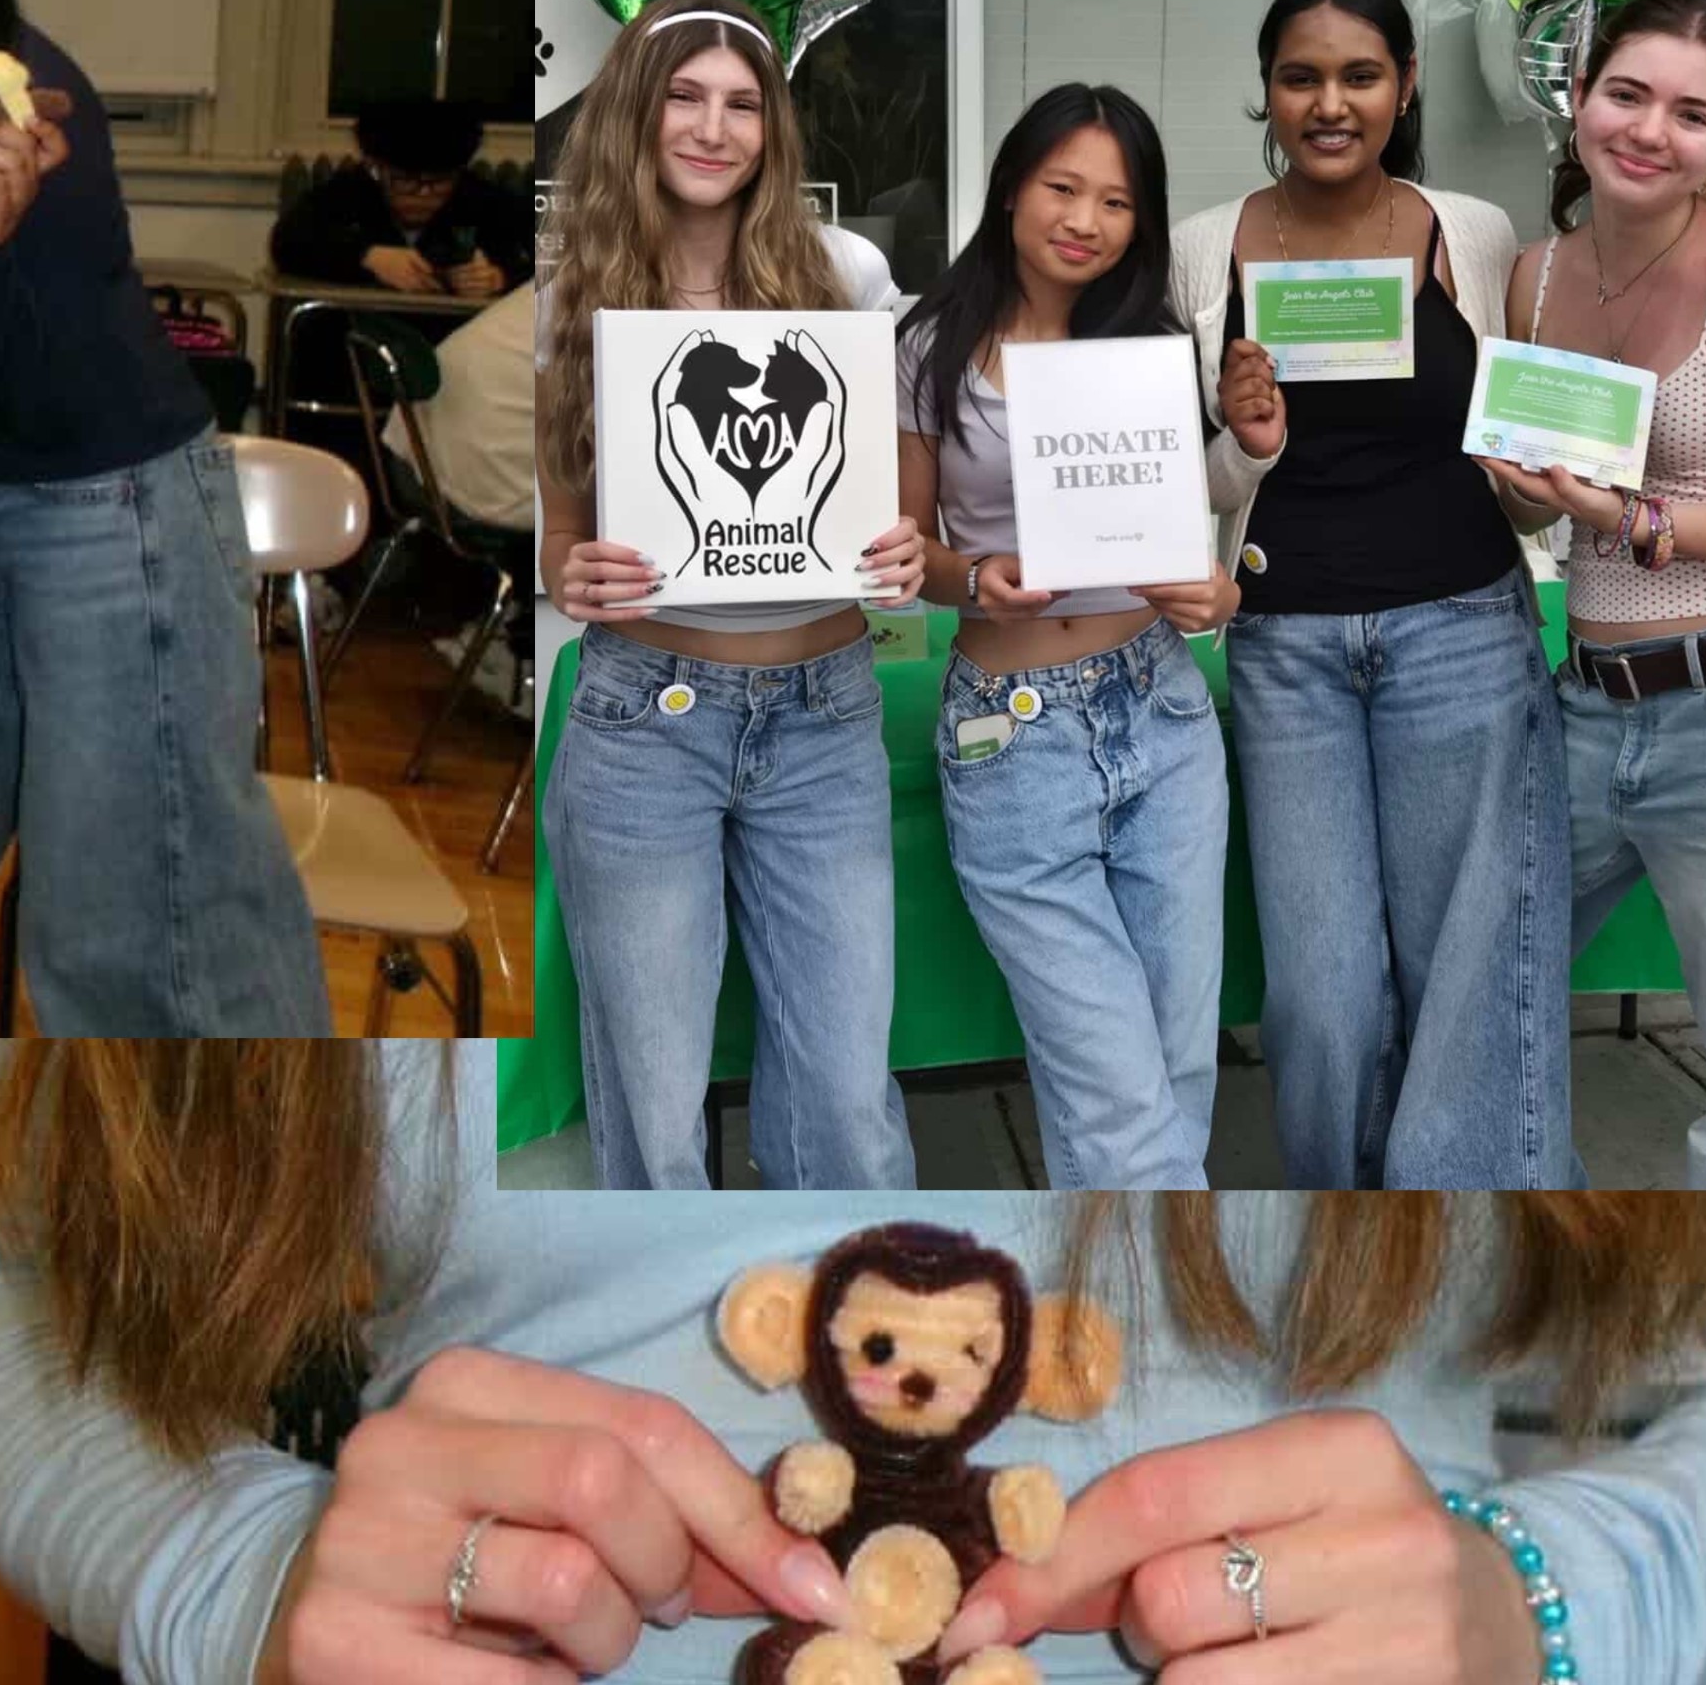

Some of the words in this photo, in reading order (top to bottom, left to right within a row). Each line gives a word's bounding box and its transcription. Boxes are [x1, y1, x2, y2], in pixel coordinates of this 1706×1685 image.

[1281, 287, 1303, 304] Join
[1303, 288, 1318, 302] the
[1318, 286, 1353, 305] Angels
[1352, 286, 1376, 301] Club
[709, 411, 797, 470] AMA
[1032, 427, 1181, 459] DONATE
[1053, 460, 1165, 490] HERE!
[703, 516, 805, 548] Animal
[703, 548, 808, 578] Rescue
